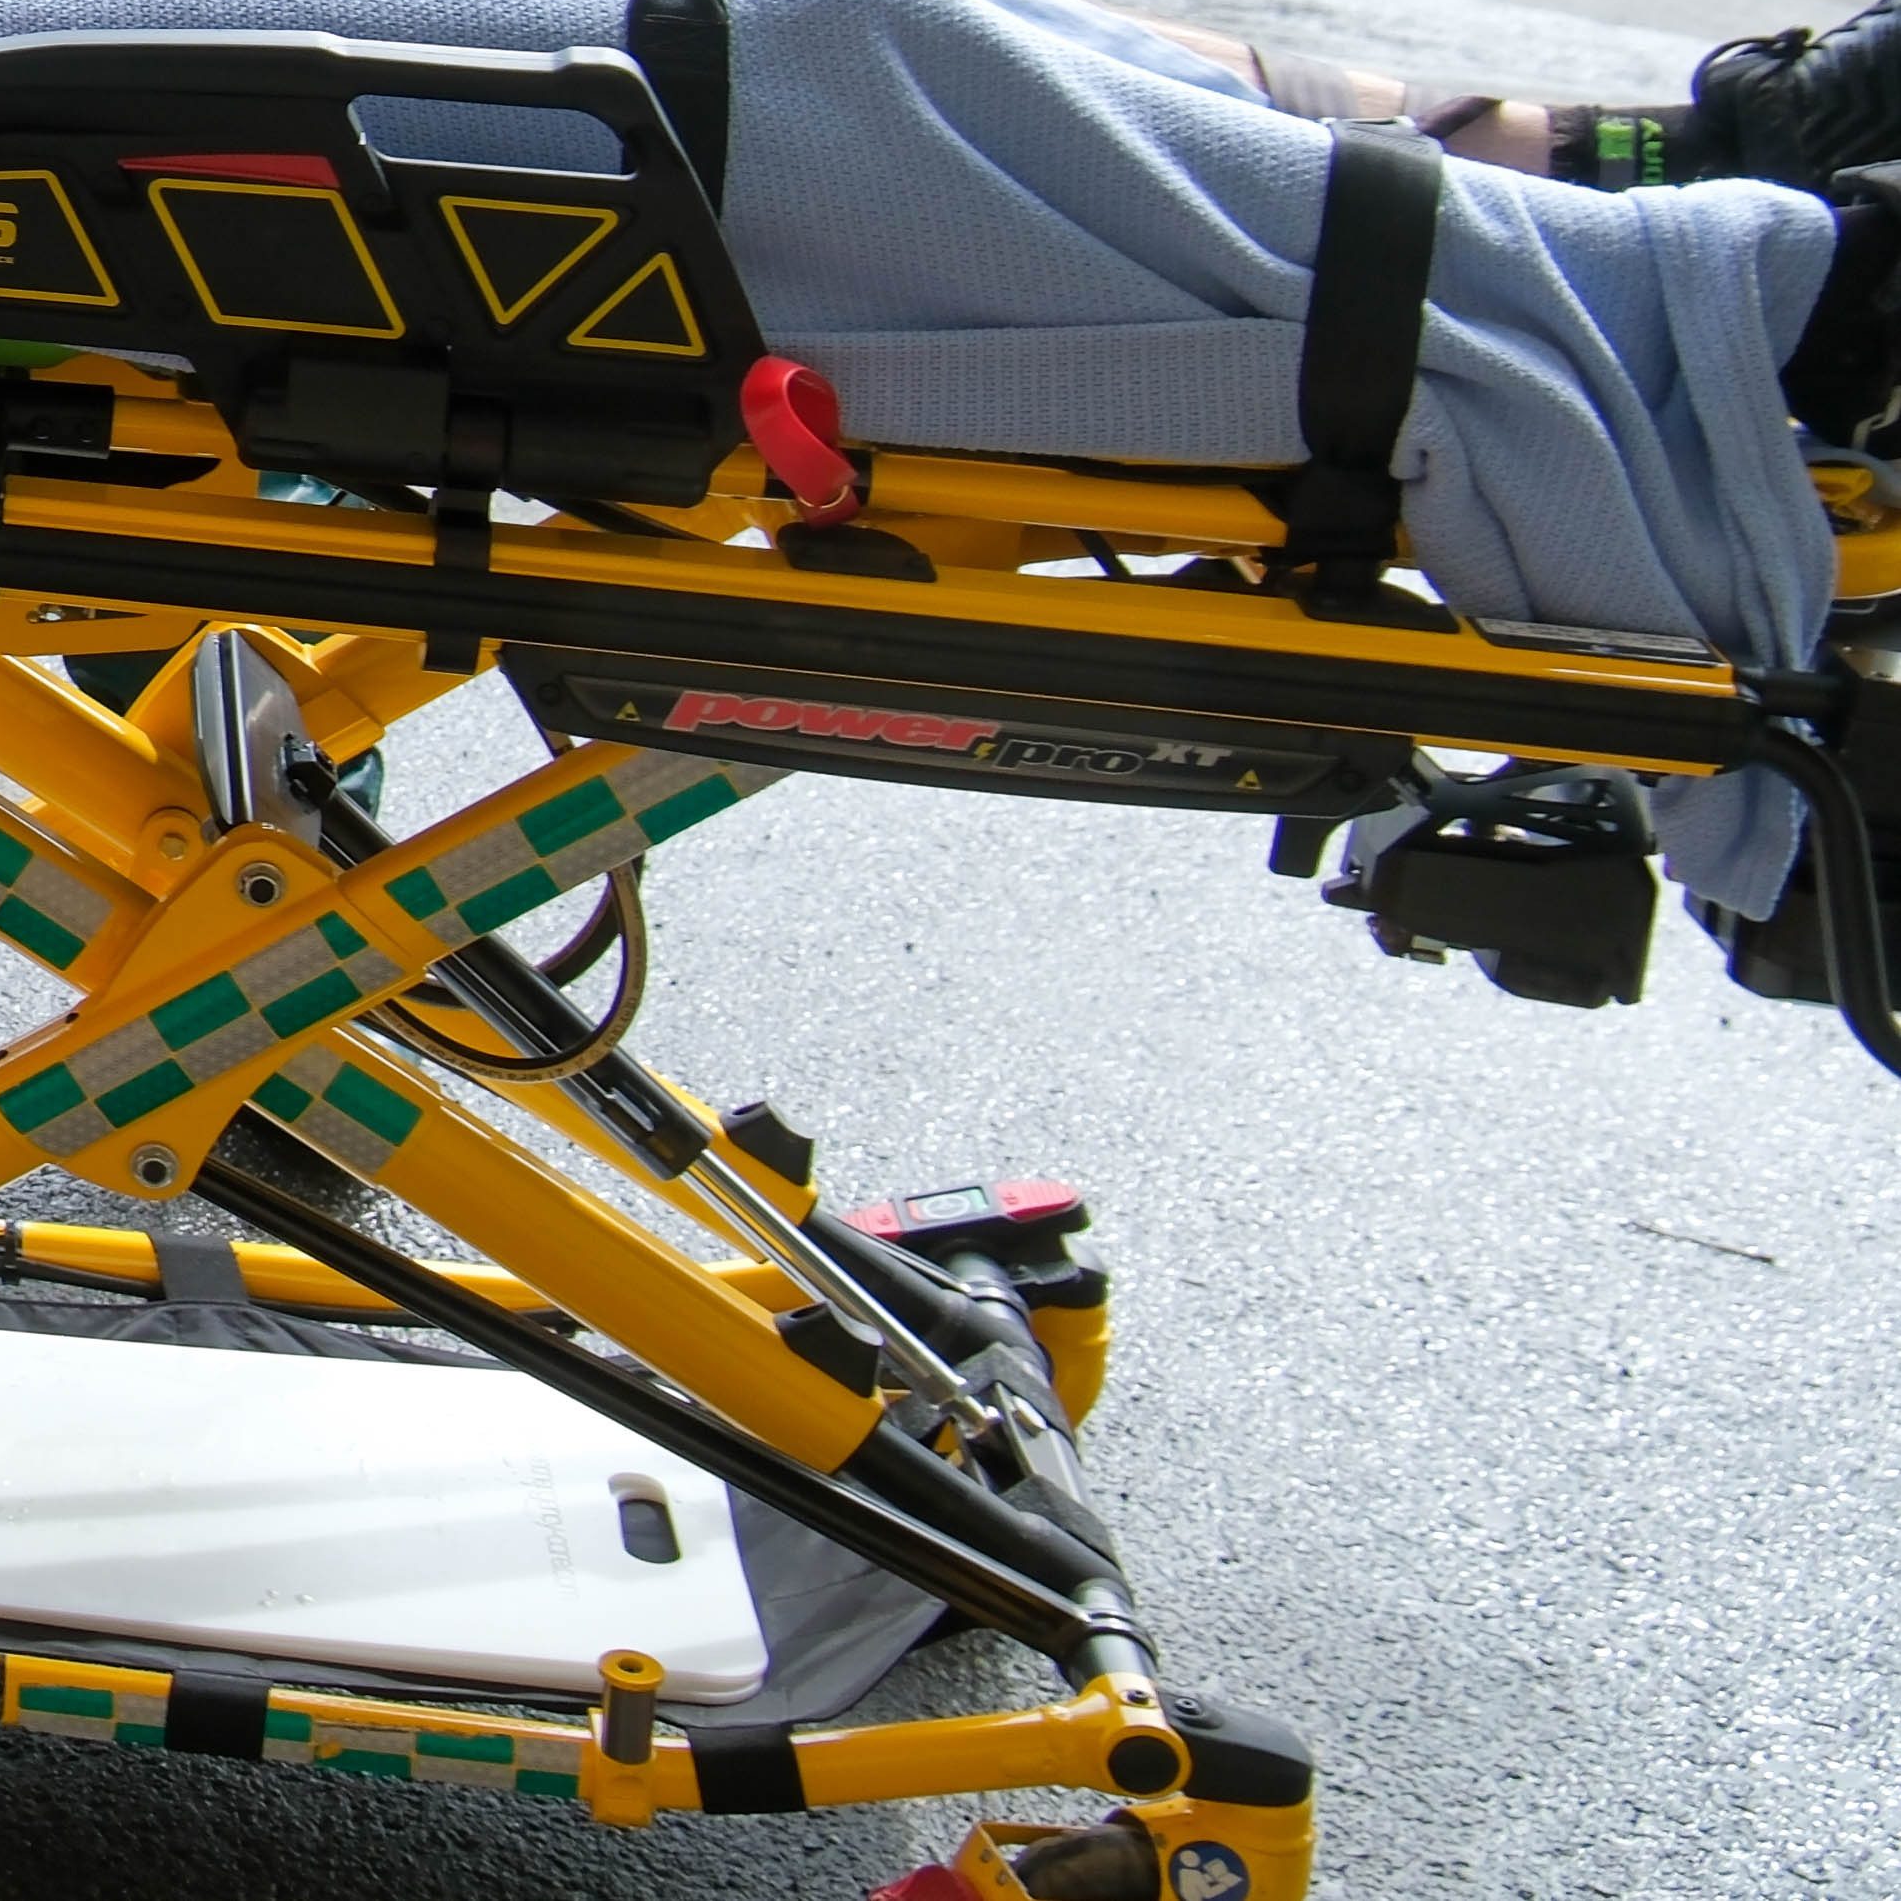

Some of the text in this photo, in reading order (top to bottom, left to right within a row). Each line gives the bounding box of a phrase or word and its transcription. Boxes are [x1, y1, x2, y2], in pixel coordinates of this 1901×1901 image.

[661, 689, 1231, 776] power pro XT
